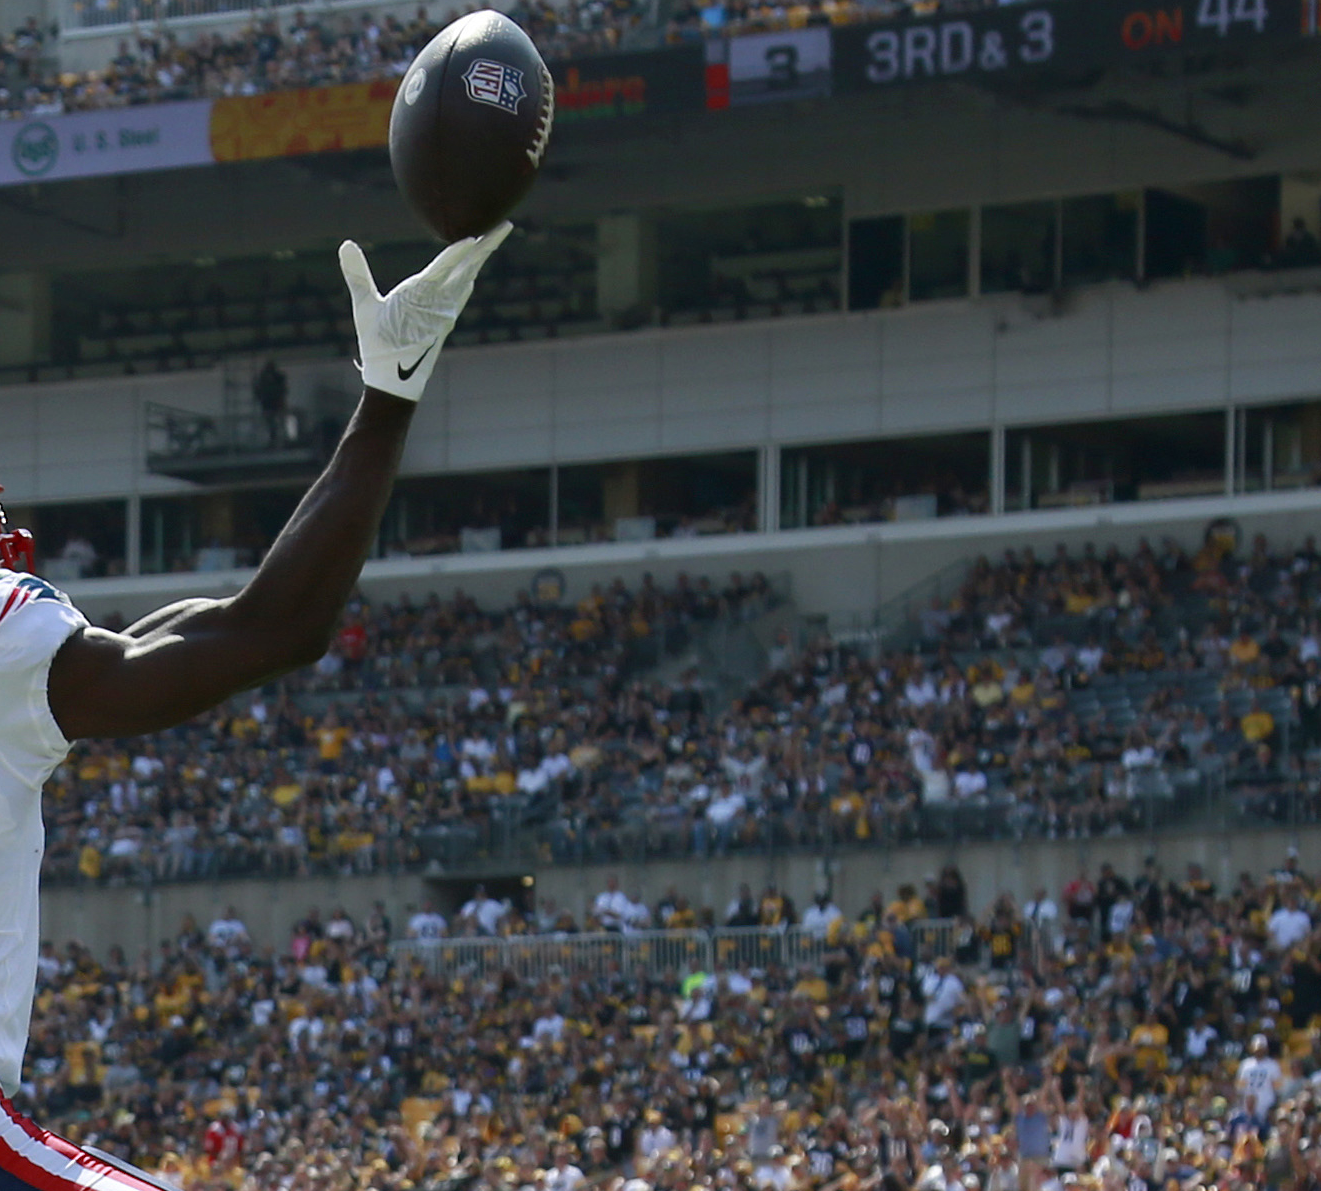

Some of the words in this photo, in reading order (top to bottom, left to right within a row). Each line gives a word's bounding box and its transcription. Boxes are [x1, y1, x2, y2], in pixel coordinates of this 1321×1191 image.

[1121, 7, 1183, 50] ON
[1197, 0, 1268, 37] 44
[471, 62, 502, 103] NFL
[765, 45, 799, 86] 3
